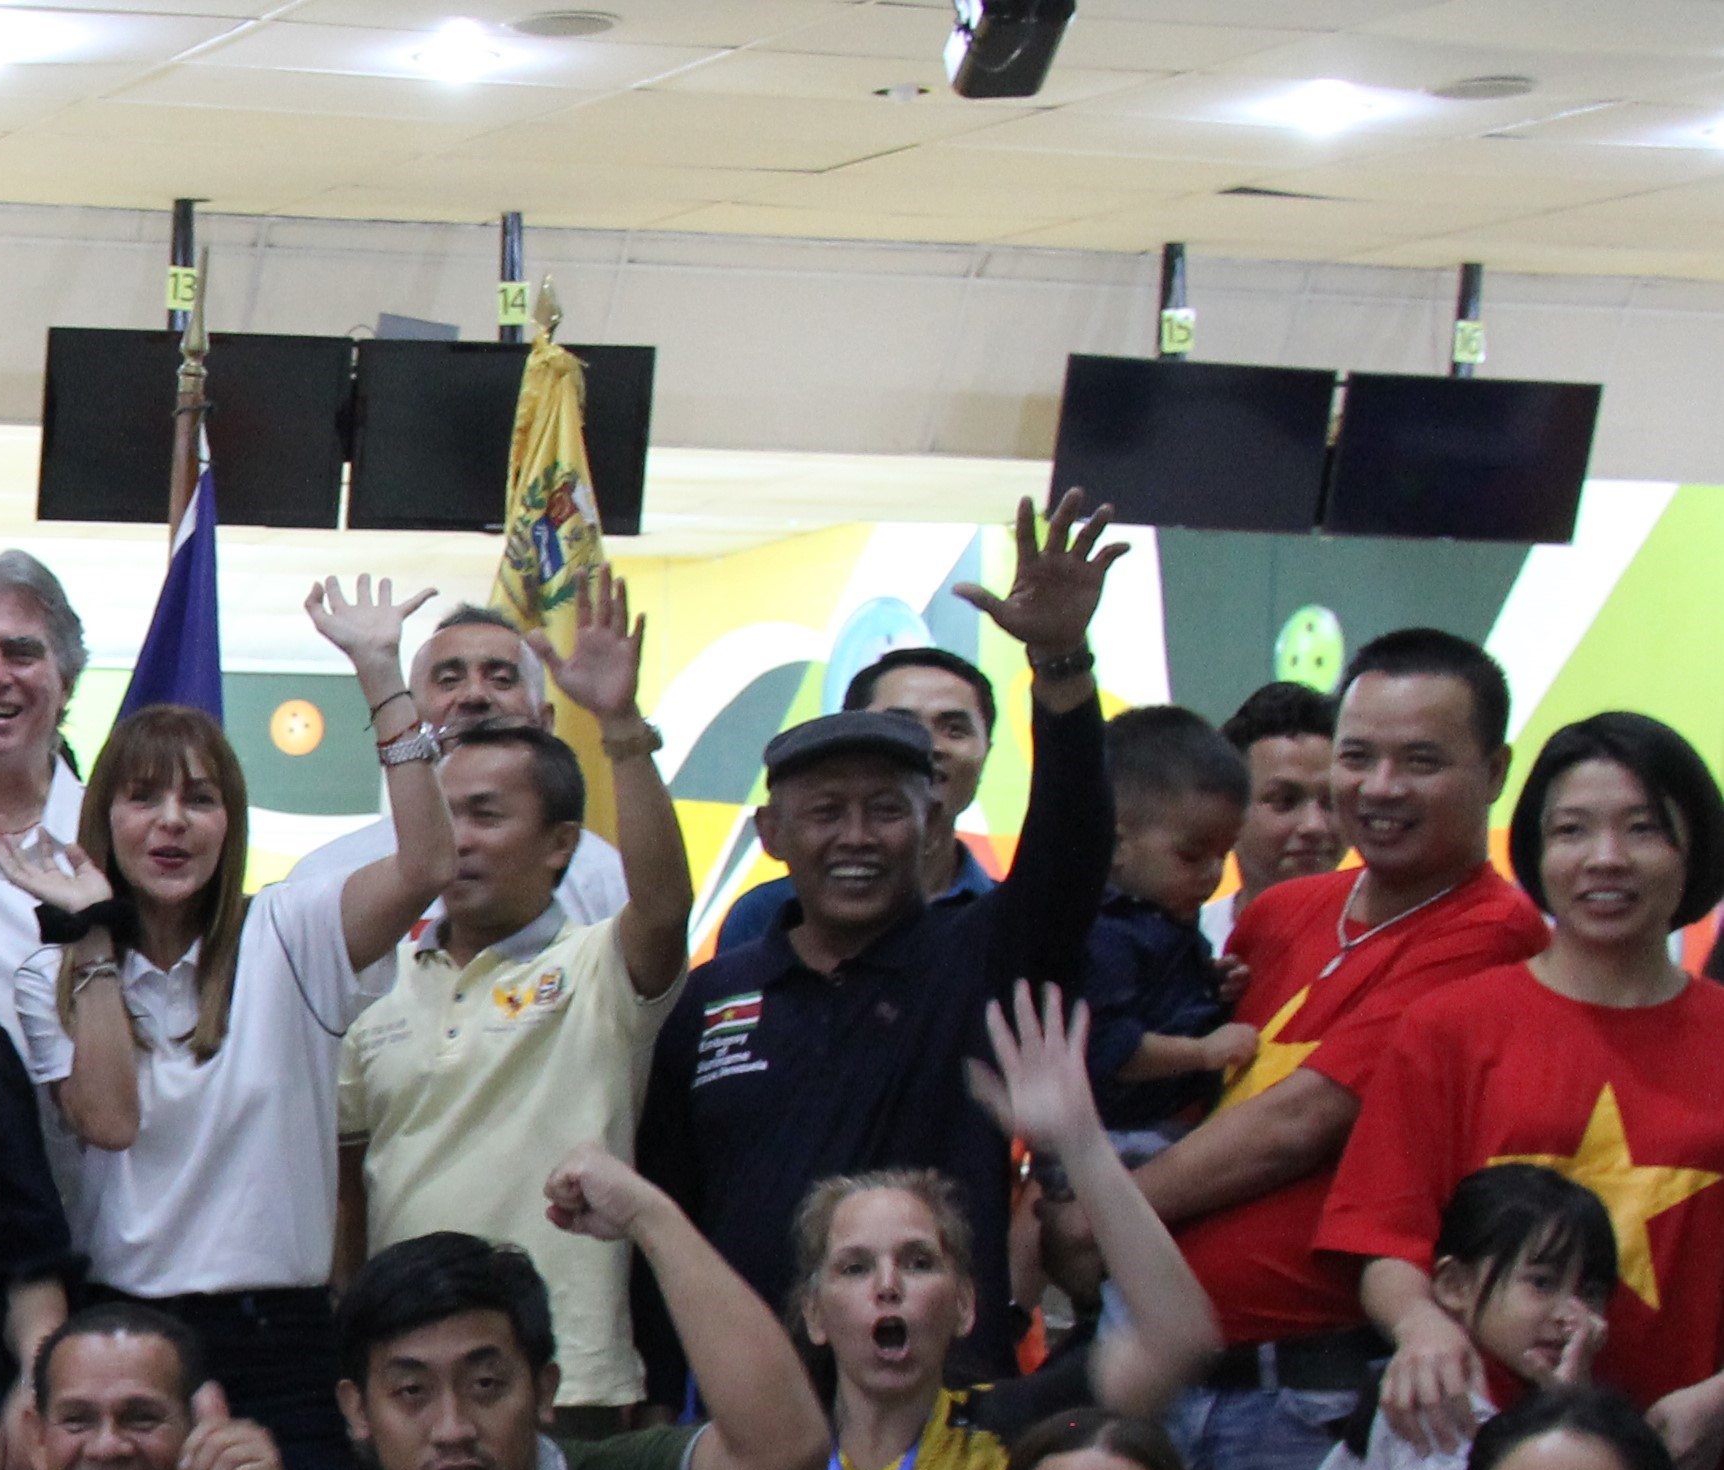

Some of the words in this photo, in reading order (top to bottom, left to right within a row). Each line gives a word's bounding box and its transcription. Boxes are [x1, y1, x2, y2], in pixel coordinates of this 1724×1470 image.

[169, 271, 197, 303] 13
[498, 287, 527, 316] 14
[1165, 314, 1192, 344] 15
[1456, 325, 1481, 356] 16
